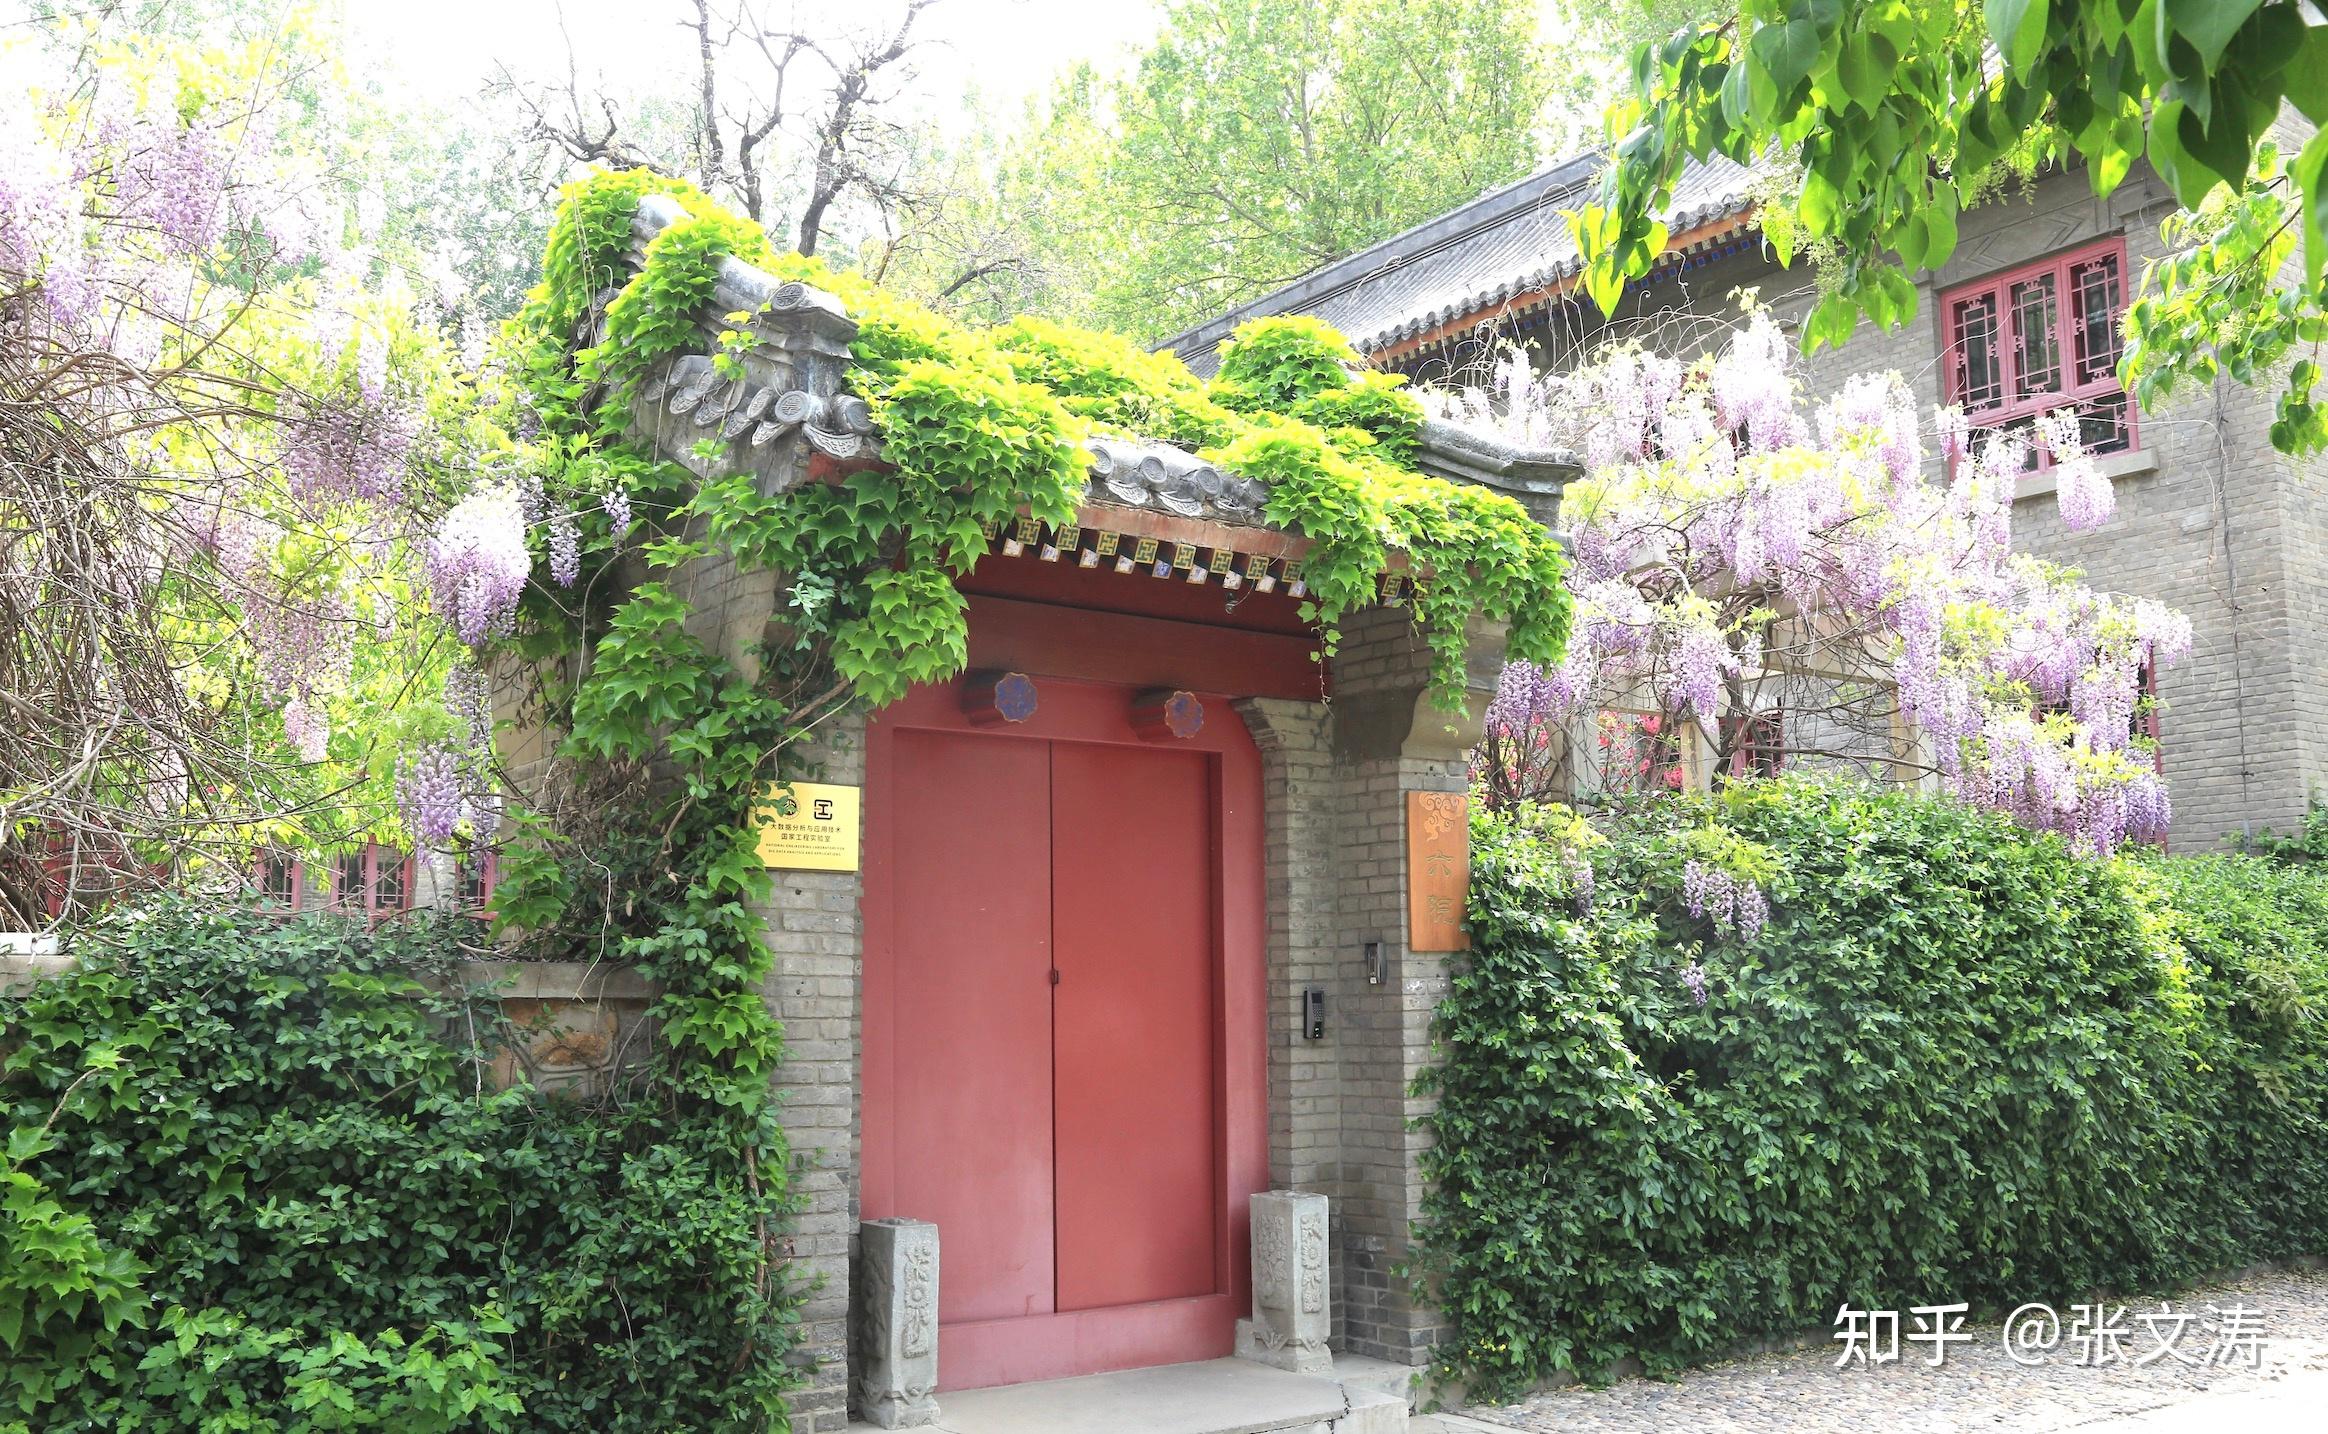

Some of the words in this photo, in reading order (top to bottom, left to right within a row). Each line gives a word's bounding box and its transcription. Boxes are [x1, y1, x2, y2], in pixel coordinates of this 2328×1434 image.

[770, 823, 840, 833] 大数据分析与应用技术
[781, 833, 831, 842] 国家工程实验室
